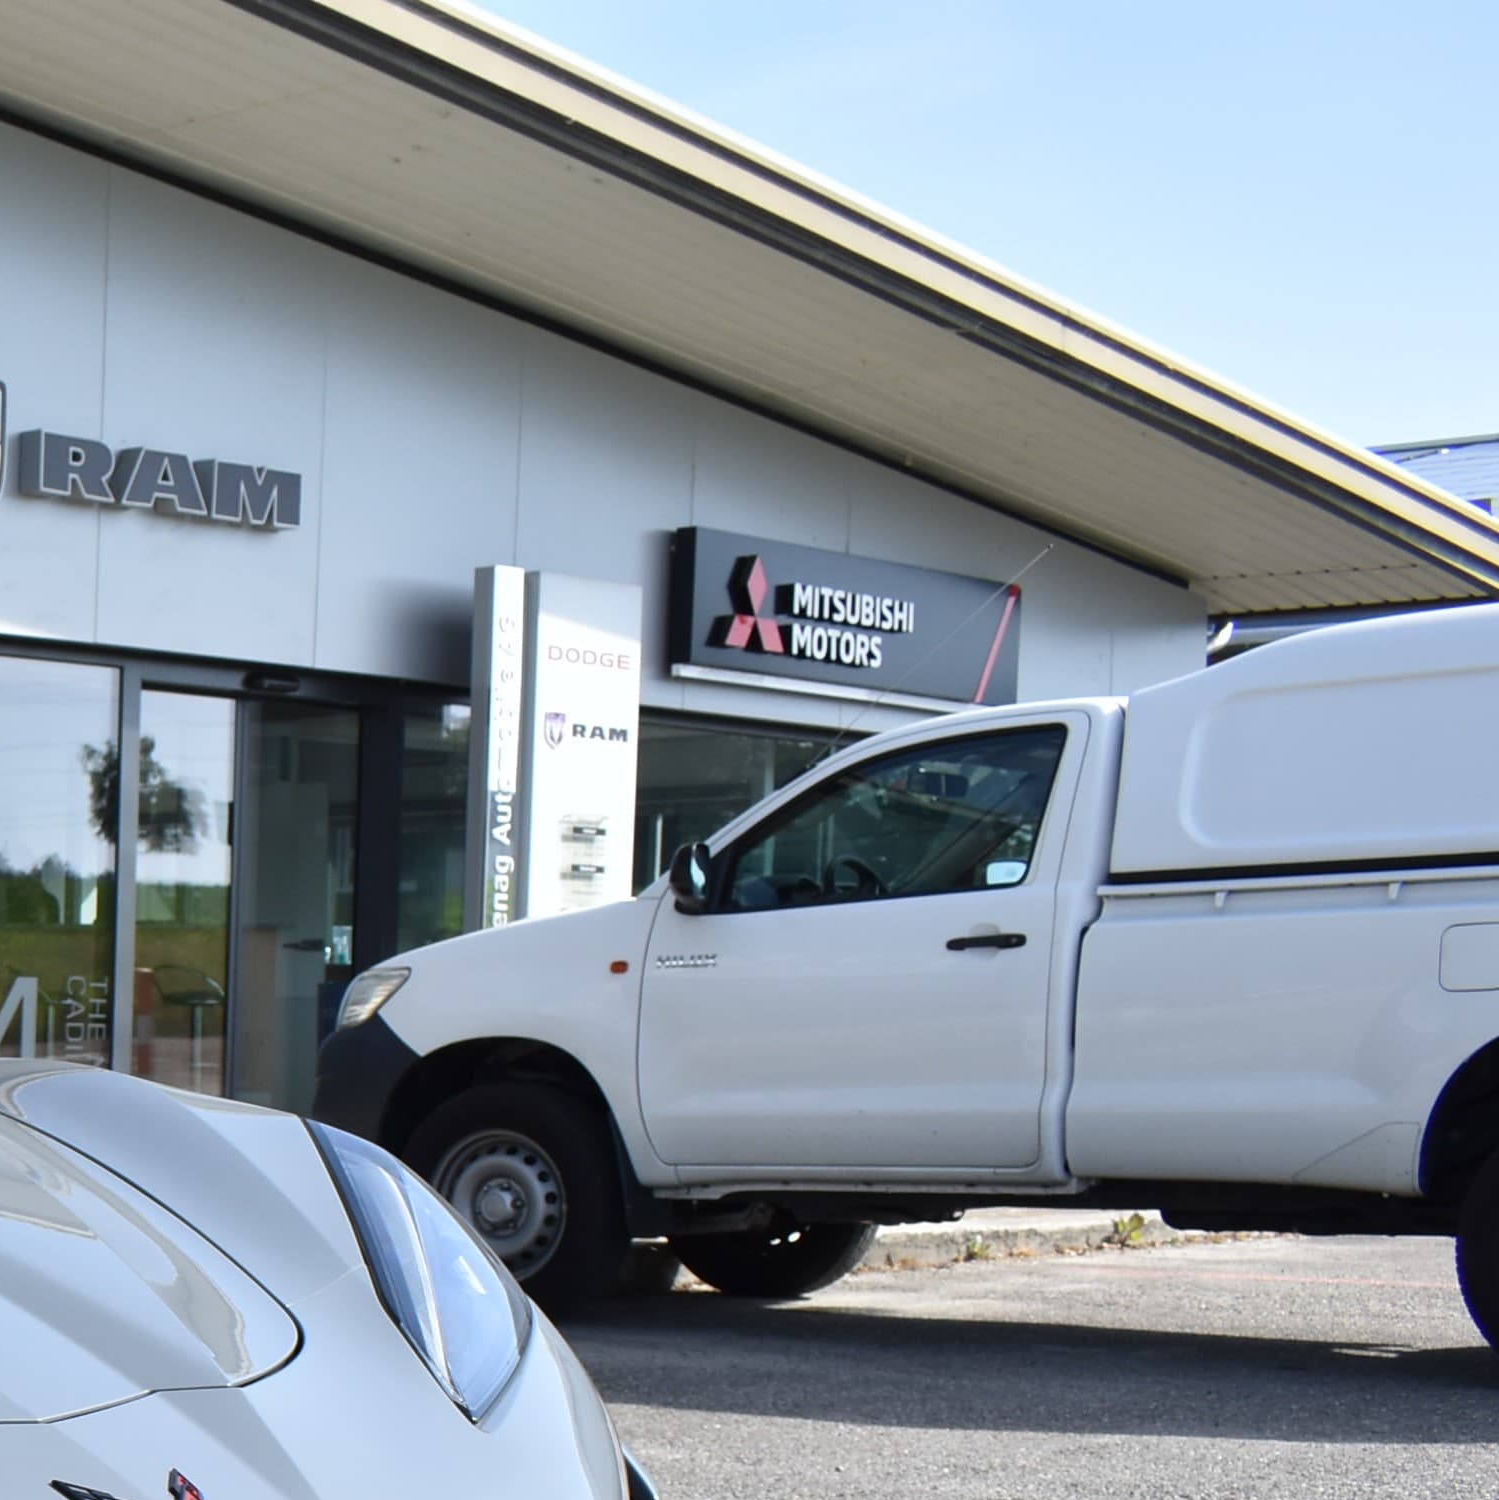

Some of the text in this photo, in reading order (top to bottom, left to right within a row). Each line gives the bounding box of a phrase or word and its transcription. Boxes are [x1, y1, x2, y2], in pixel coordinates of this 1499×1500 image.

[23, 429, 302, 529] RAM
[791, 582, 915, 634] MITSUBISHI
[547, 645, 631, 670] DODGE
[790, 623, 883, 669] MOTORS
[572, 723, 628, 743] RAM
[491, 853, 515, 928] enag
[87, 976, 109, 1041] THE
